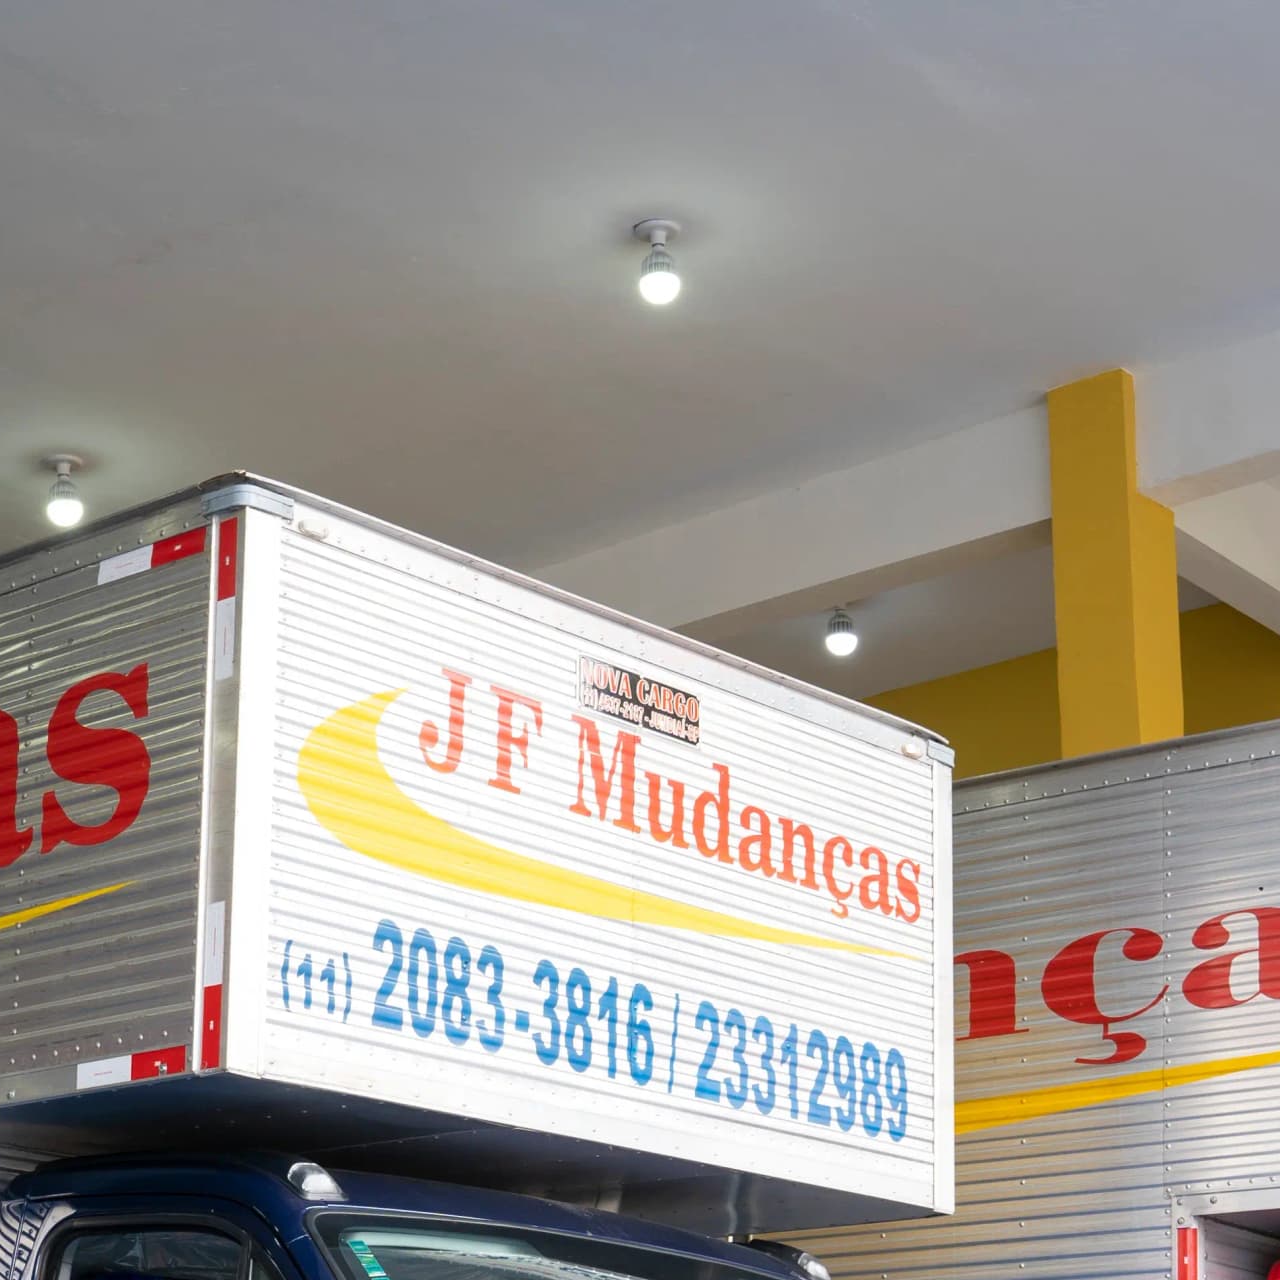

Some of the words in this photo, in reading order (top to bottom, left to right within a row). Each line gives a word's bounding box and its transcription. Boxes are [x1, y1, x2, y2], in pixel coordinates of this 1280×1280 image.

[581, 657, 633, 700] NOVA
[636, 678, 700, 723] CARGO
[569, 714, 922, 923] Mudanças
[281, 940, 353, 1024] (11)
[371, 919, 654, 1087] 2083-3816
[694, 1001, 909, 1142] 23312989
